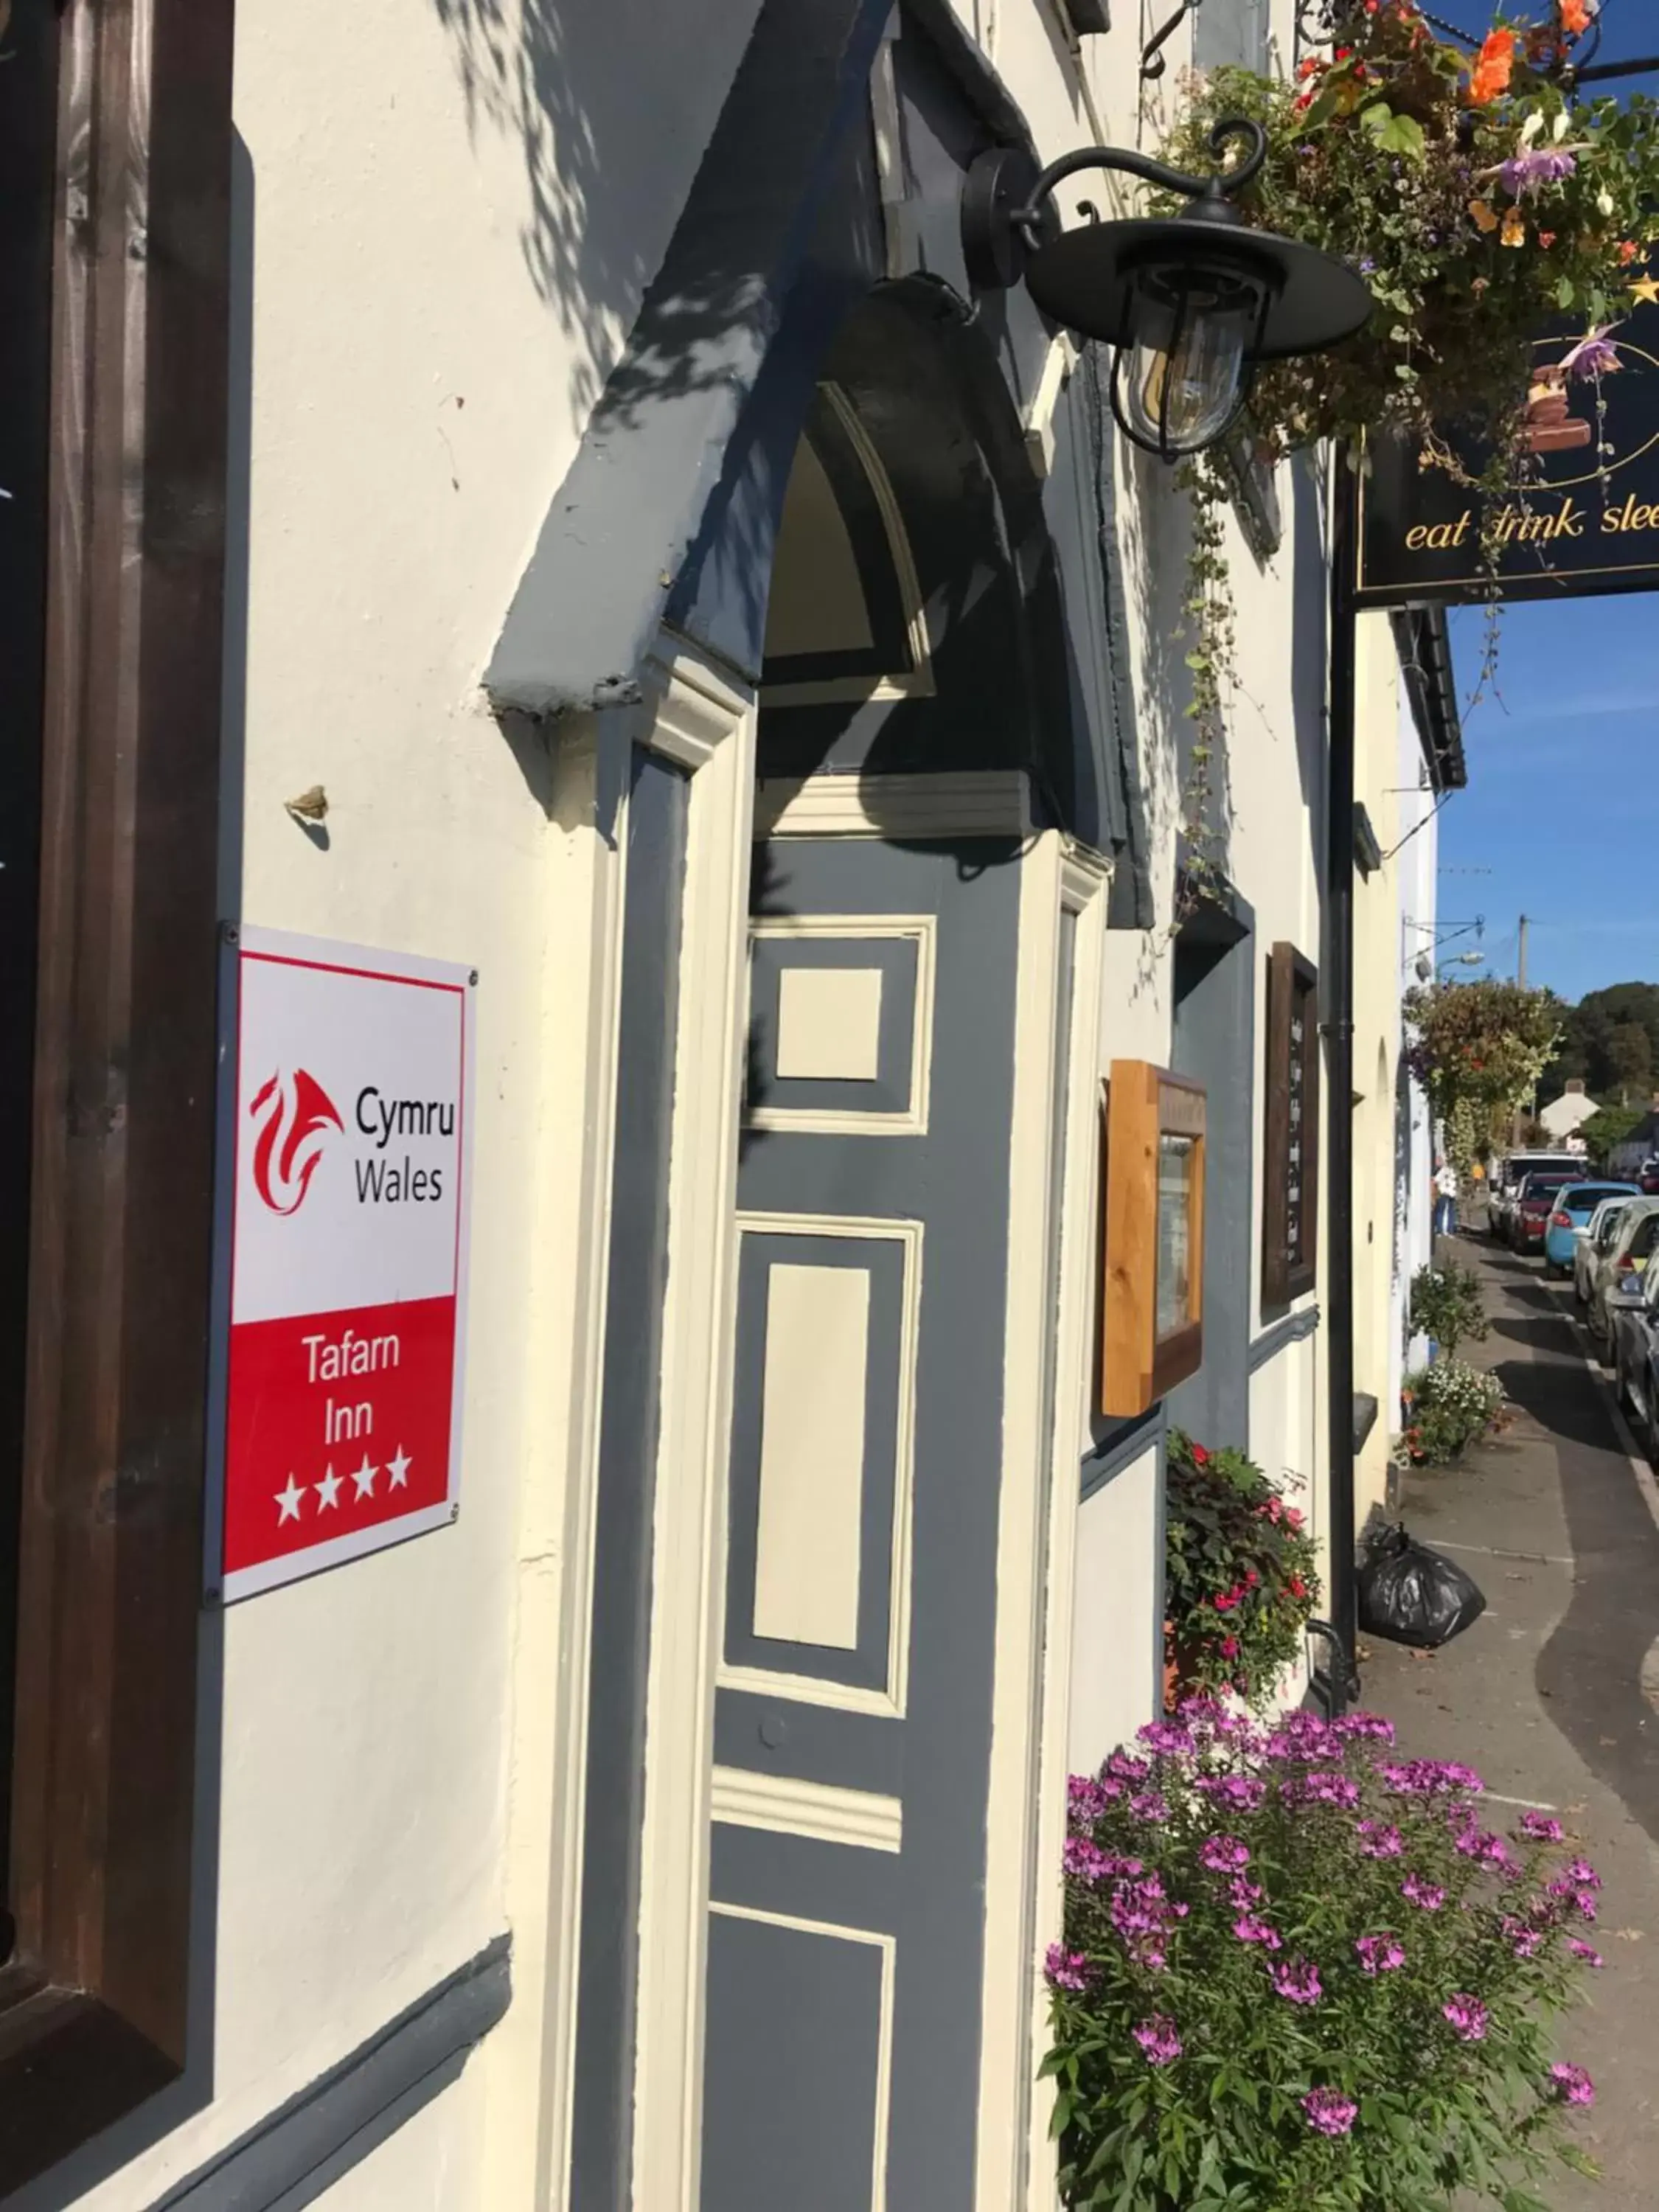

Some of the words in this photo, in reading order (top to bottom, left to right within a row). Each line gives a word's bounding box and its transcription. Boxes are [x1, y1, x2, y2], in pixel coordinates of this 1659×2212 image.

[1405, 509, 1472, 551] eat
[356, 1086, 454, 1149] Cymru
[355, 1155, 442, 1203] Wales
[301, 1329, 400, 1382] Tafarn
[325, 1398, 372, 1445] Inn
